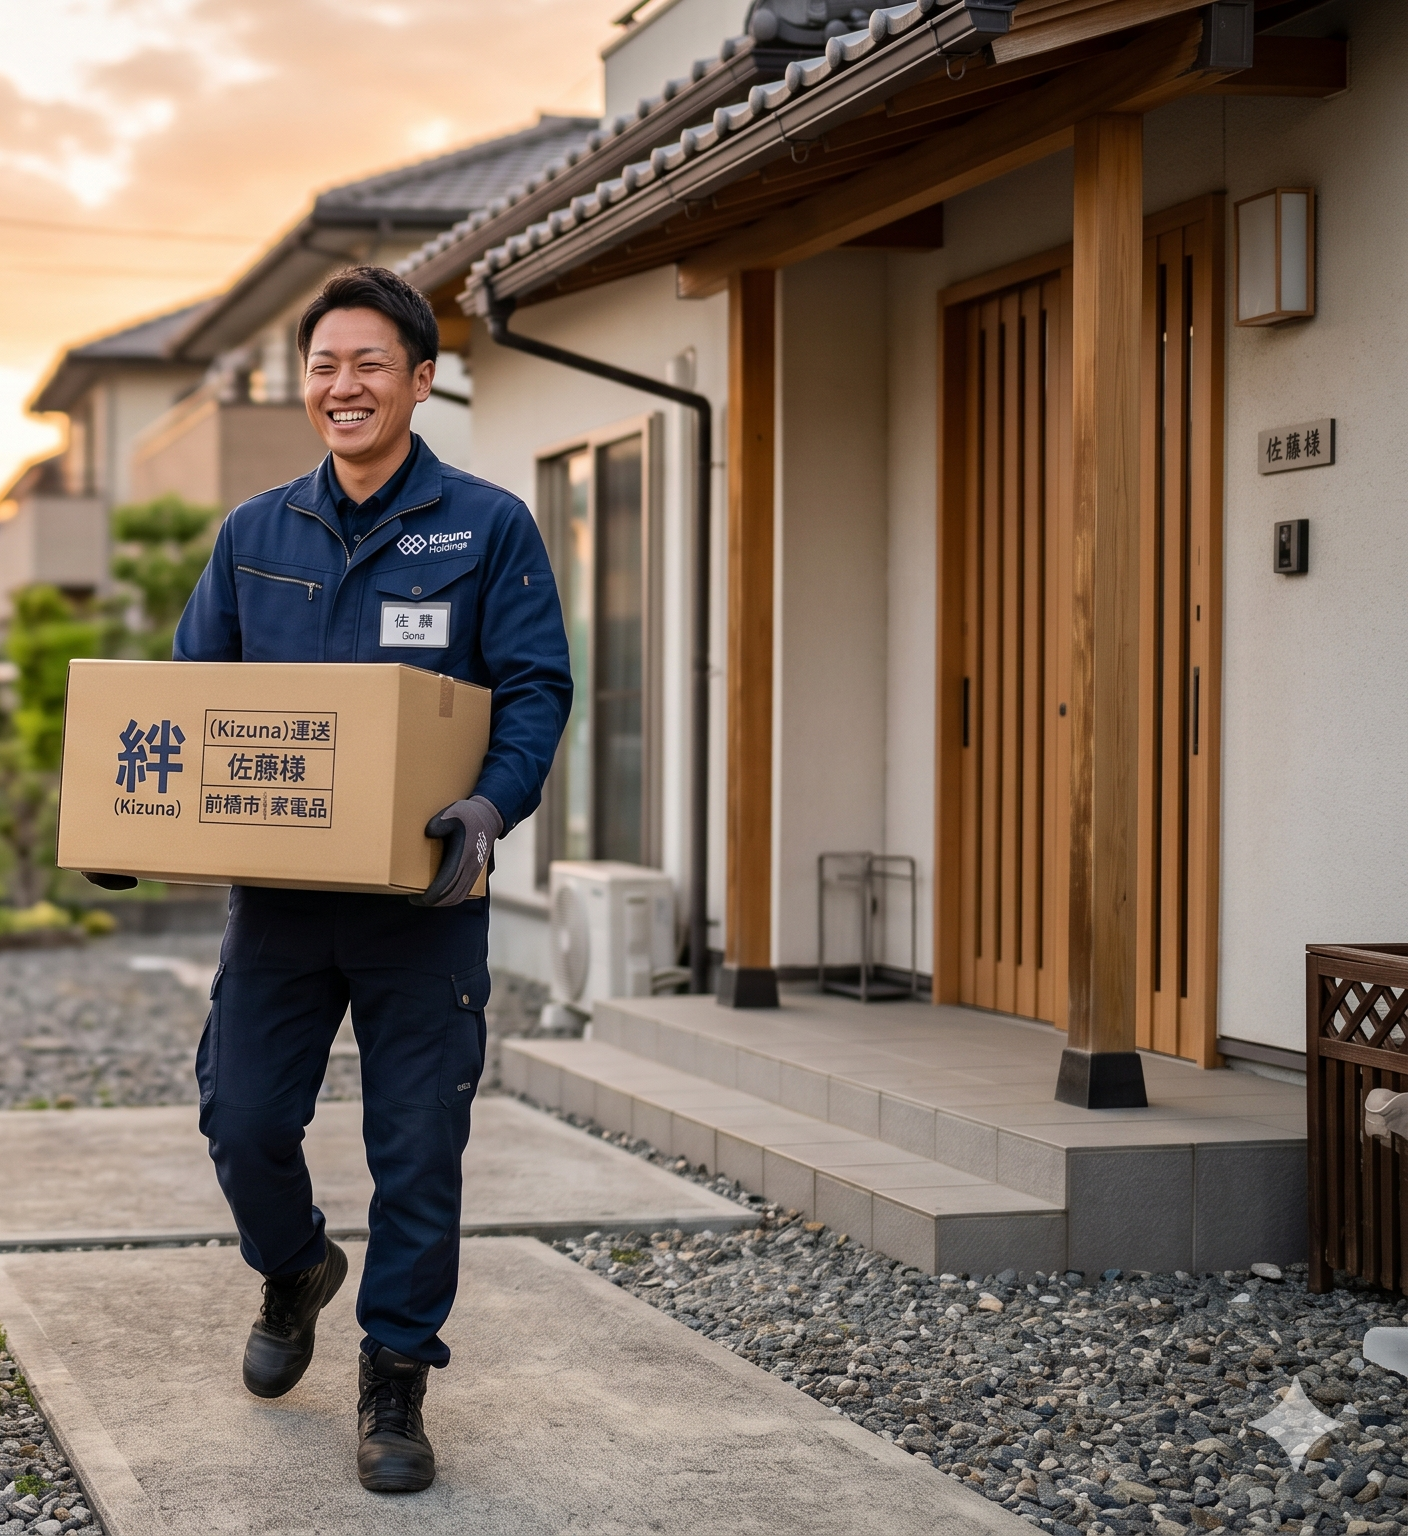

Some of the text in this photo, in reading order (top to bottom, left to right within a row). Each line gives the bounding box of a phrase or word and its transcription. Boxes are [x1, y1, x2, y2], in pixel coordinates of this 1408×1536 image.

[1266, 428, 1321, 463] 佐藤様
[429, 531, 472, 545] Kizuna
[429, 542, 468, 554] Holdings
[115, 718, 186, 794] 絆
[227, 753, 306, 782] 佐藤様
[114, 797, 182, 819] (Kizuna)
[270, 796, 328, 819] 家電品
